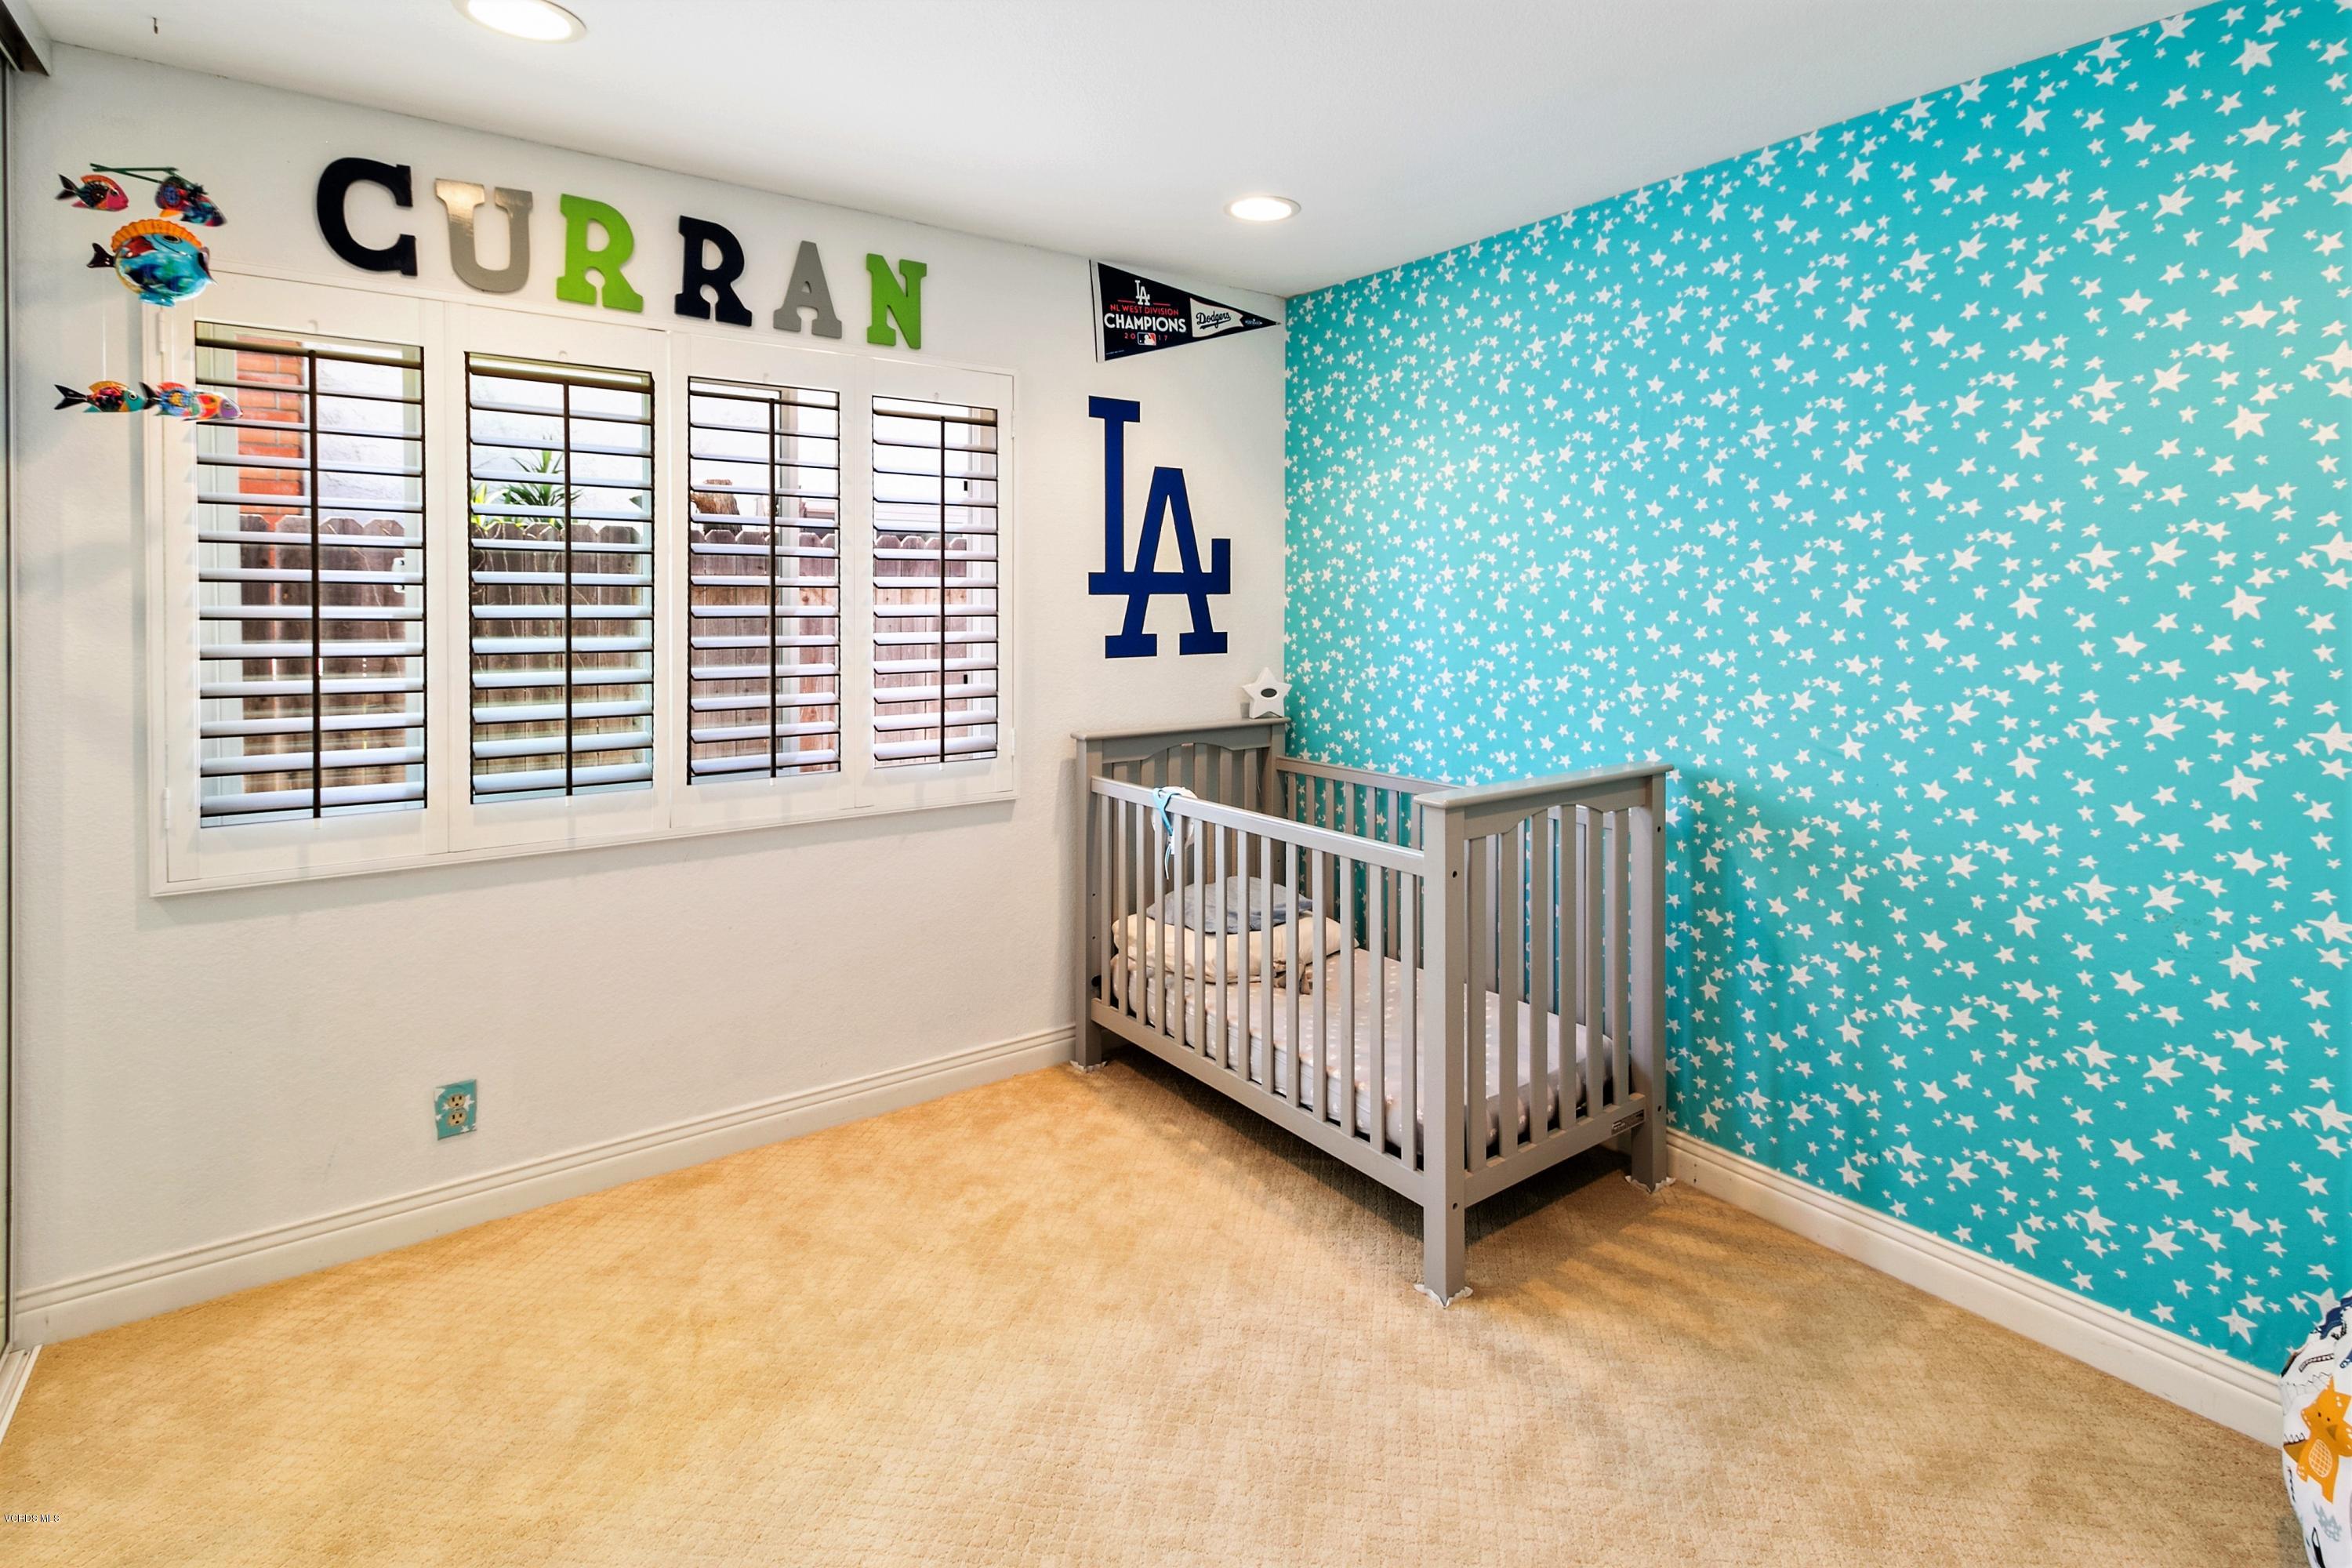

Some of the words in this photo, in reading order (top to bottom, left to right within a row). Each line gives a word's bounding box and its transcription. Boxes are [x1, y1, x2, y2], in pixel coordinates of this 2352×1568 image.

[317, 157, 927, 349] CURRAN
[1134, 280, 1150, 306] LA
[1121, 304, 1142, 314] WEST
[1145, 307, 1179, 316] DIVISION
[1196, 310, 1232, 328] Dodgers
[1104, 313, 1187, 332] CHAMPIONS
[1089, 395, 1231, 659] LA
